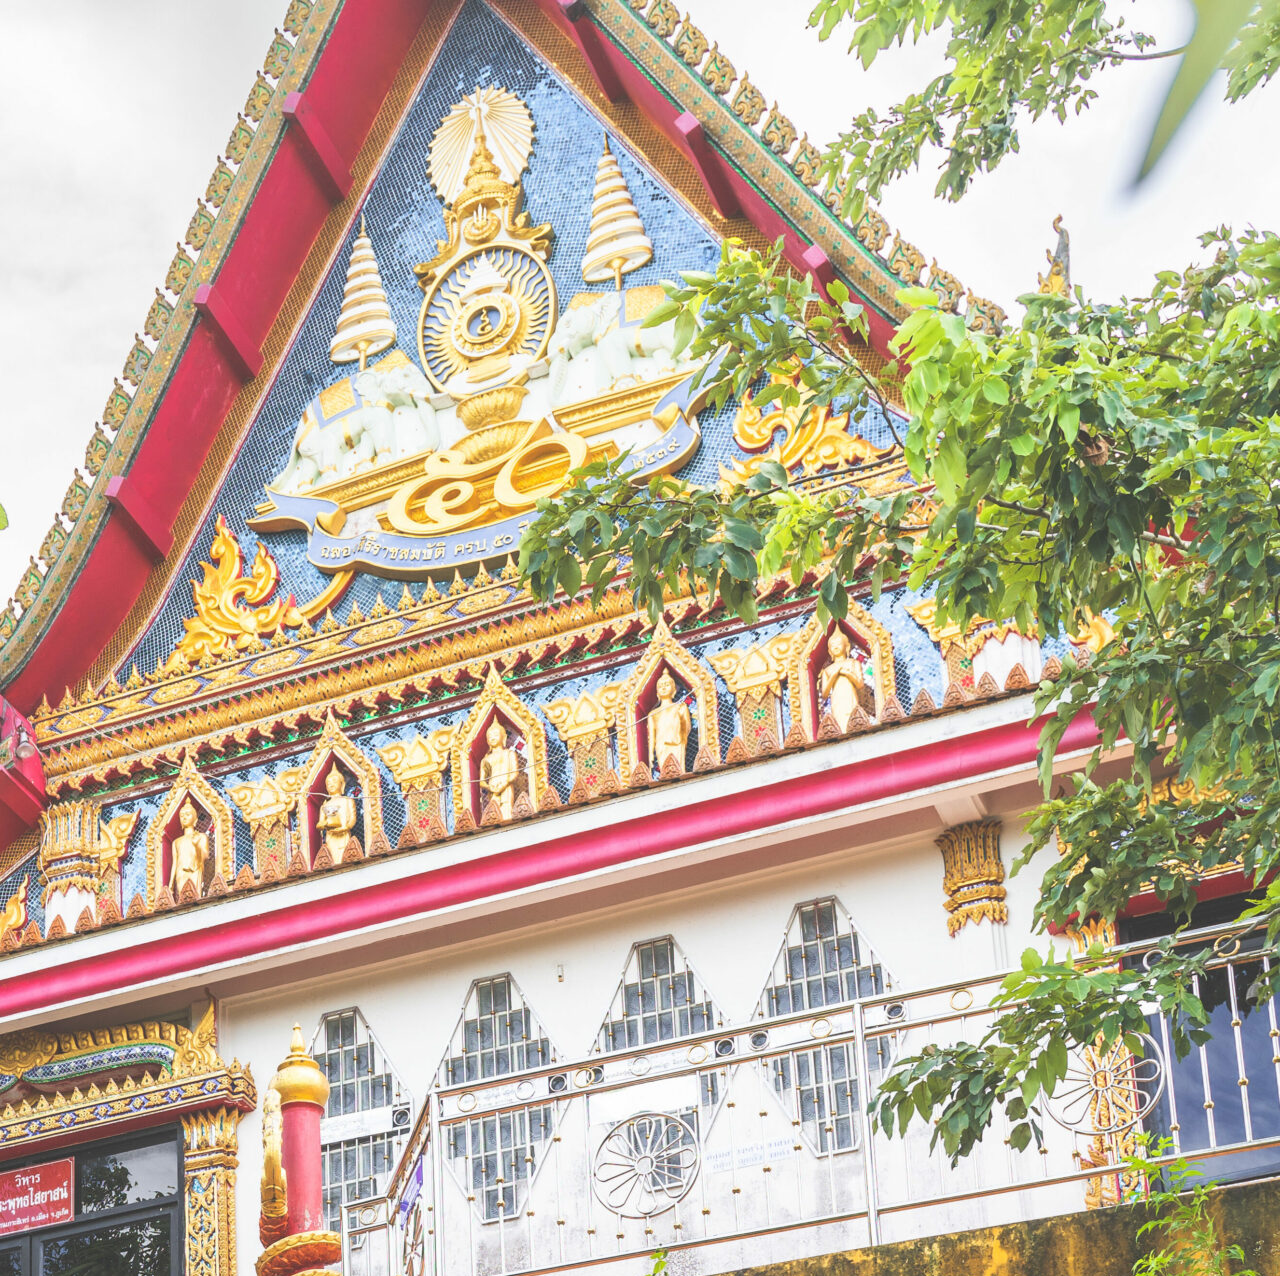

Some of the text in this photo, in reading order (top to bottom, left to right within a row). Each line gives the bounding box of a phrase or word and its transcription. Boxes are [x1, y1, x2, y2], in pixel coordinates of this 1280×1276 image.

[453, 540, 487, 556] ครบ
[492, 534, 514, 549] ๕๐
[15, 1173, 40, 1188] วิหาร
